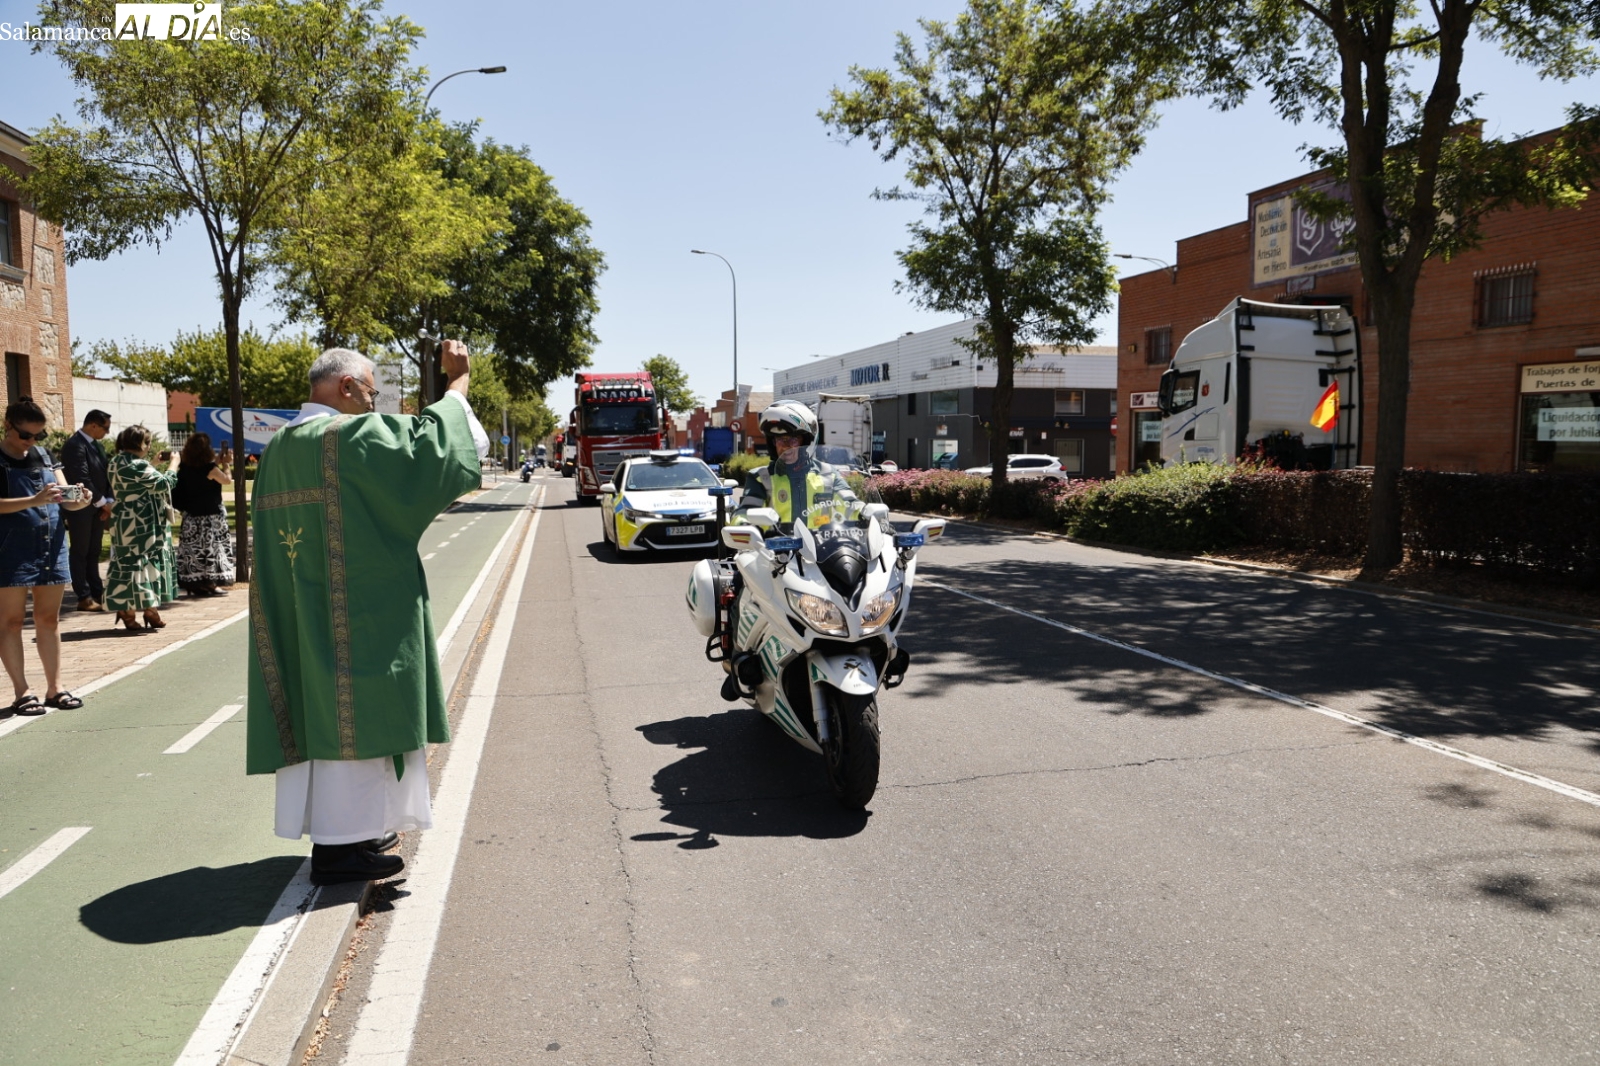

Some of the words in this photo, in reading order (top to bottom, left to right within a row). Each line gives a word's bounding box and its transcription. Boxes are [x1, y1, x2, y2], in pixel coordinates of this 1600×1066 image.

[1527, 367, 1565, 377] Trabajos
[1568, 366, 1581, 374] de
[1536, 380, 1576, 388] Puertas
[1581, 378, 1595, 387] de
[600, 390, 638, 399] NANO
[1549, 429, 1566, 439] por
[802, 500, 842, 517] GUARDIA
